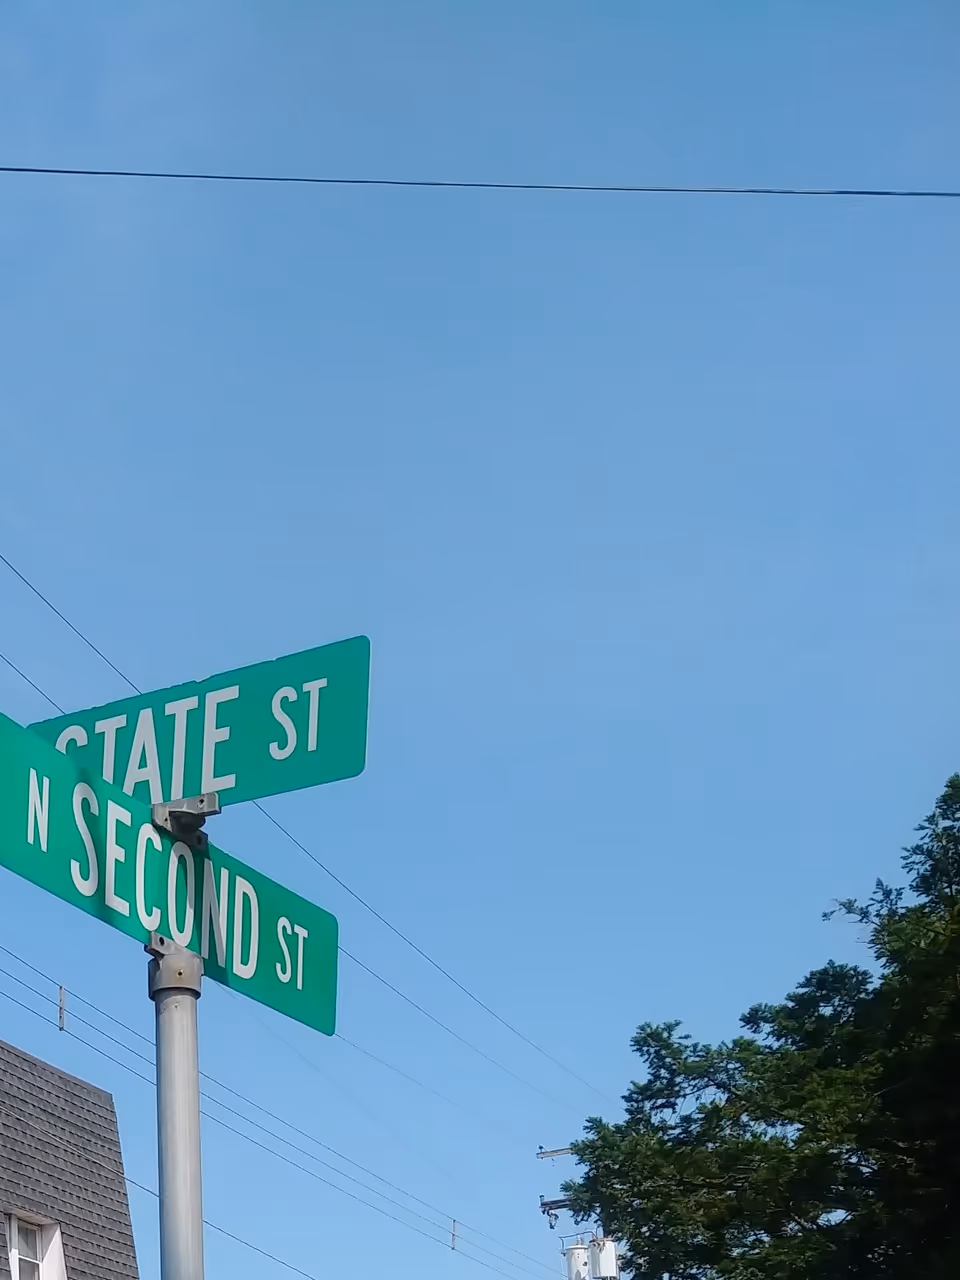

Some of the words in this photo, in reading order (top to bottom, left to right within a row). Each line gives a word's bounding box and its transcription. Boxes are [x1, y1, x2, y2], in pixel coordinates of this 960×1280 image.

[269, 678, 328, 760] ST
[26, 767, 50, 852] N
[70, 782, 259, 980] SECOND
[275, 916, 309, 991] ST
